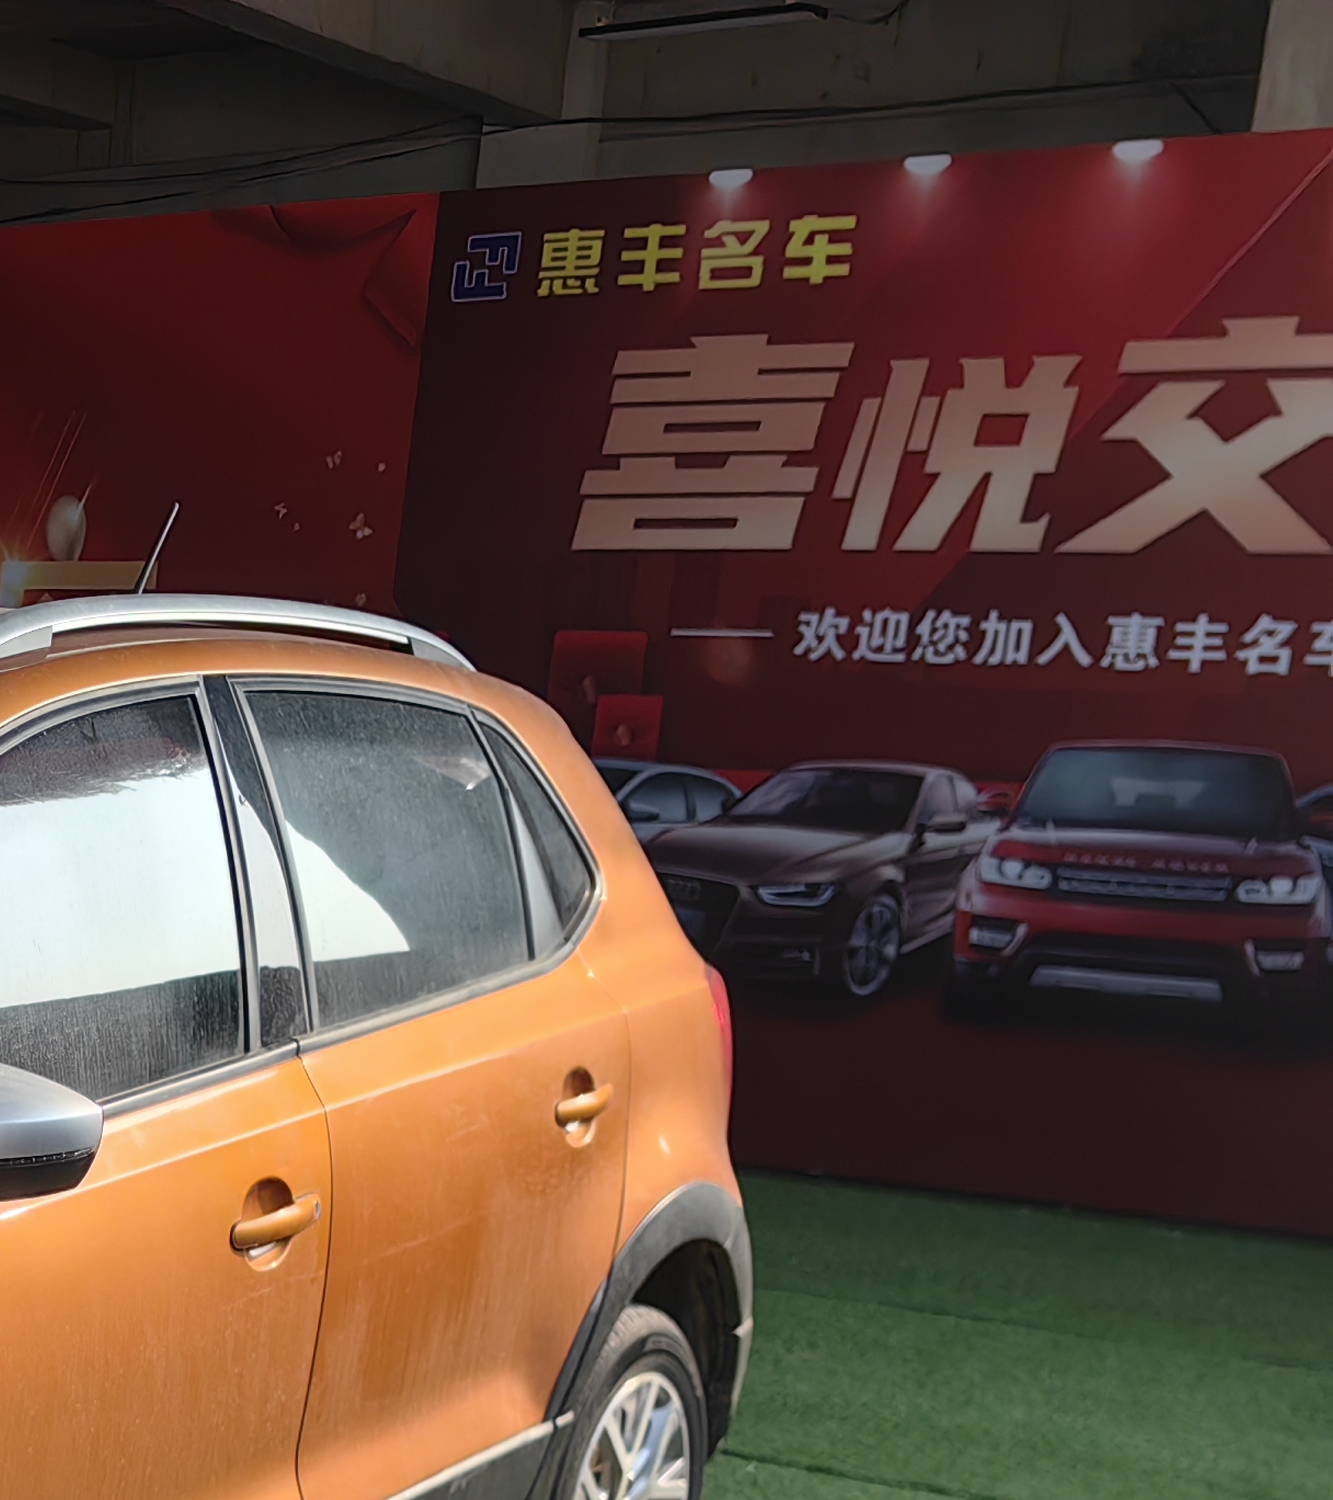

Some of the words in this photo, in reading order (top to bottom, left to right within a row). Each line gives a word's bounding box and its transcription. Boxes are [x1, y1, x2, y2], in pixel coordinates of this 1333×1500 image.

[537, 214, 858, 298] 惠丰名车
[570, 315, 1333, 555] 喜悦交
